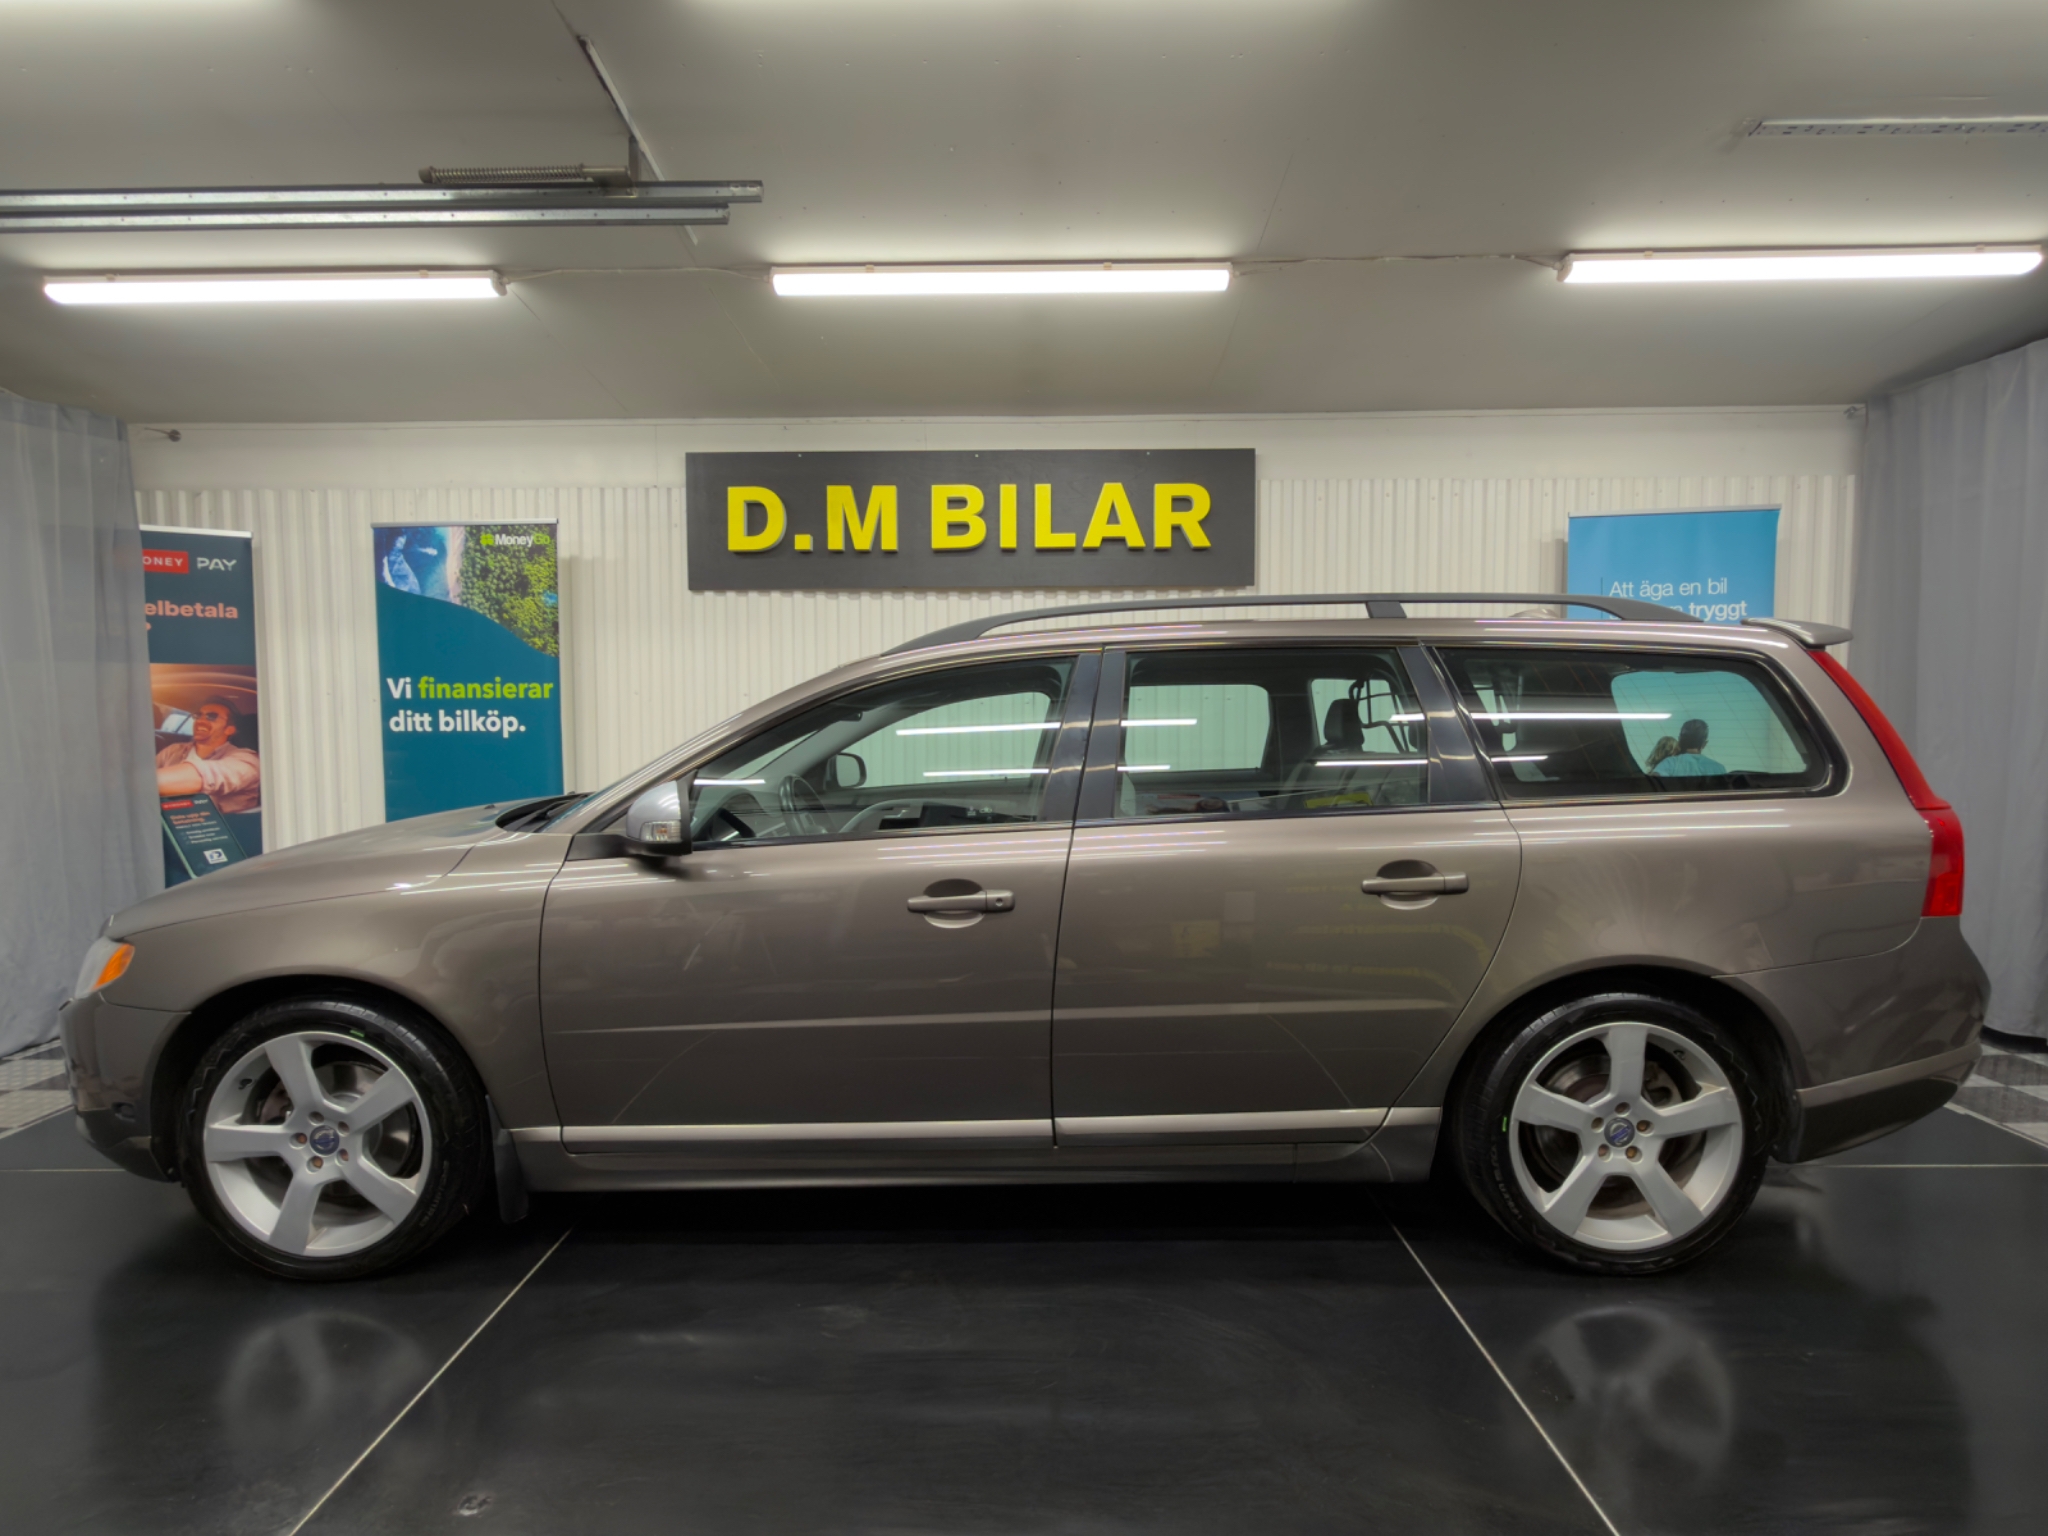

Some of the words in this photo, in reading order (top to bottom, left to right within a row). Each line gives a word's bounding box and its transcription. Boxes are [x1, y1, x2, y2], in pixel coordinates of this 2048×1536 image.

[727, 484, 899, 553] D.M
[930, 481, 1212, 551] BILAR
[494, 533, 551, 547] MoneyGo
[196, 557, 237, 571] PAY
[1609, 581, 1634, 597] Att
[1639, 580, 1674, 601] äga
[1679, 582, 1701, 595] en
[1708, 577, 1728, 595] bil
[1688, 600, 1747, 621] tryggt
[387, 677, 412, 699] Vi
[418, 676, 553, 699] finansierar
[389, 709, 432, 733] ditt
[438, 709, 526, 738] bilköp.
